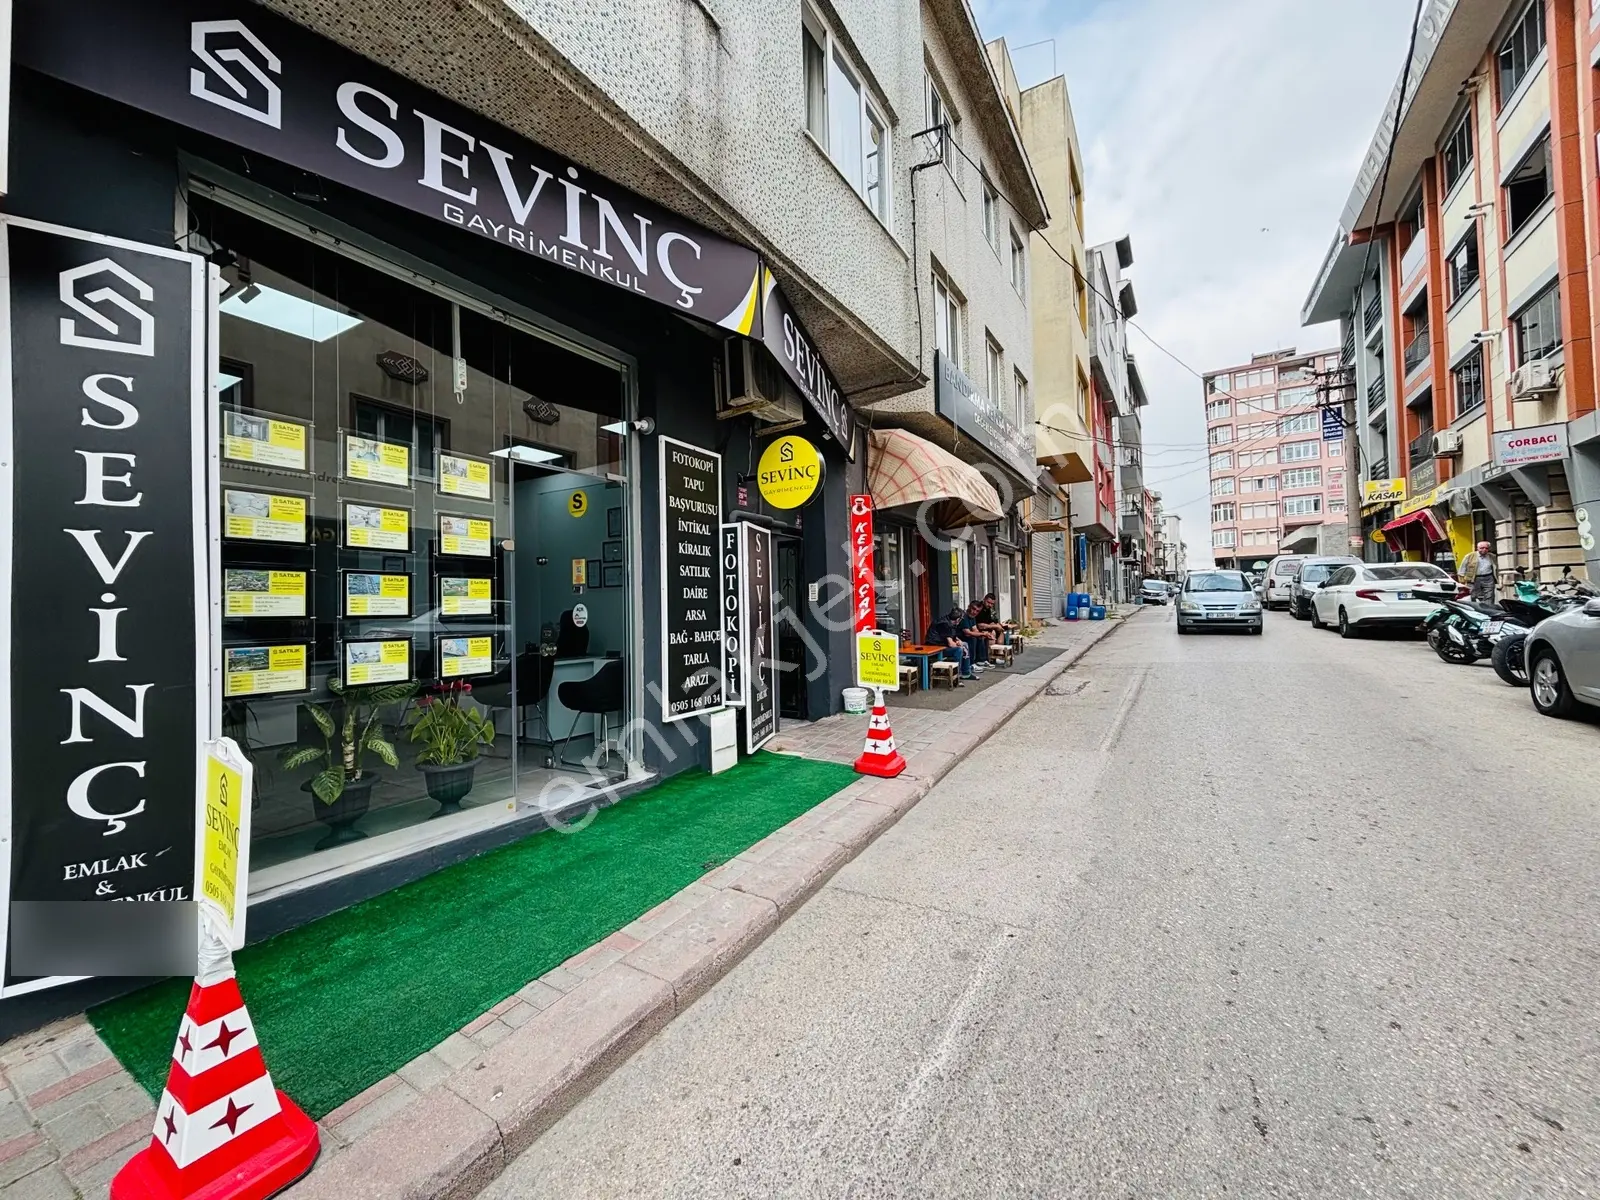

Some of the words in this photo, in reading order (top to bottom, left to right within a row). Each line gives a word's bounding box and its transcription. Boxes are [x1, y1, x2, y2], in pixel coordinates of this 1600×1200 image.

[336, 81, 703, 309] SEVİNÇ
[443, 202, 646, 294] GAYRİMENKUL
[783, 312, 839, 436] SEVİNÇ
[1508, 434, 1557, 449] ÇORBACI
[672, 450, 714, 474] FOTOKOPİ
[760, 464, 816, 485] SEVİNÇ
[683, 476, 705, 492] TAPU
[572, 493, 583, 509] S
[1368, 490, 1403, 500] KASAP
[669, 495, 718, 516] BAŞVURUSU
[678, 517, 711, 536] İNTİKAL
[678, 540, 712, 557] KİRALIK
[679, 565, 711, 578] SATILIK
[683, 585, 708, 599] DAİRE
[60, 373, 155, 837] SEVİNÇ
[724, 533, 739, 694] FOTOKOPİ
[755, 533, 766, 686] SEVİNÇ
[685, 609, 707, 621] ARSA
[669, 629, 688, 645] BAĞ
[694, 629, 721, 645] BAHÇE
[683, 652, 710, 666] TARLA
[860, 652, 896, 665] SEVİNÇ
[684, 671, 709, 689] ARAZİ
[671, 699, 689, 712] 0505
[690, 697, 702, 709] 168
[704, 695, 712, 705] 10
[713, 694, 721, 704] 34
[63, 852, 148, 880] EMLAK
[95, 880, 117, 895] &
